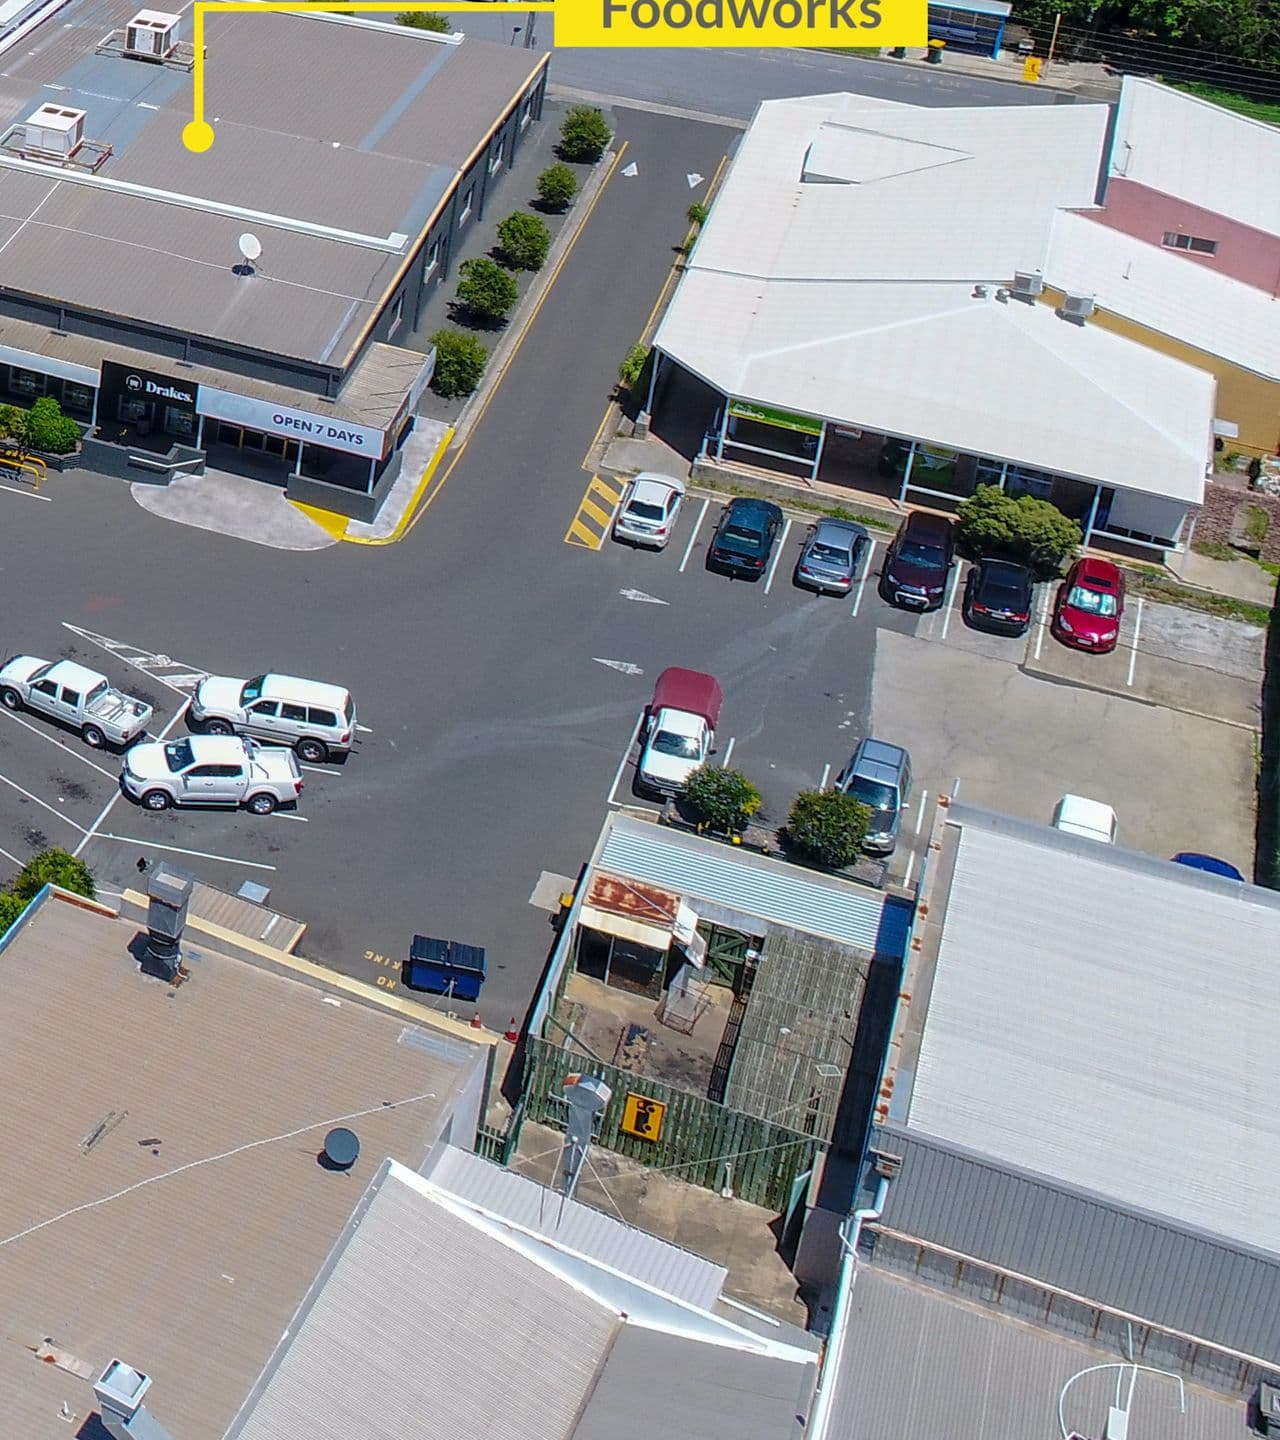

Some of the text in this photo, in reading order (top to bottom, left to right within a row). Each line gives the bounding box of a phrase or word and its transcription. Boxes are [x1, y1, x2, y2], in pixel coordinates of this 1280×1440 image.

[272, 414, 364, 445] OPEN 7 DAYS
